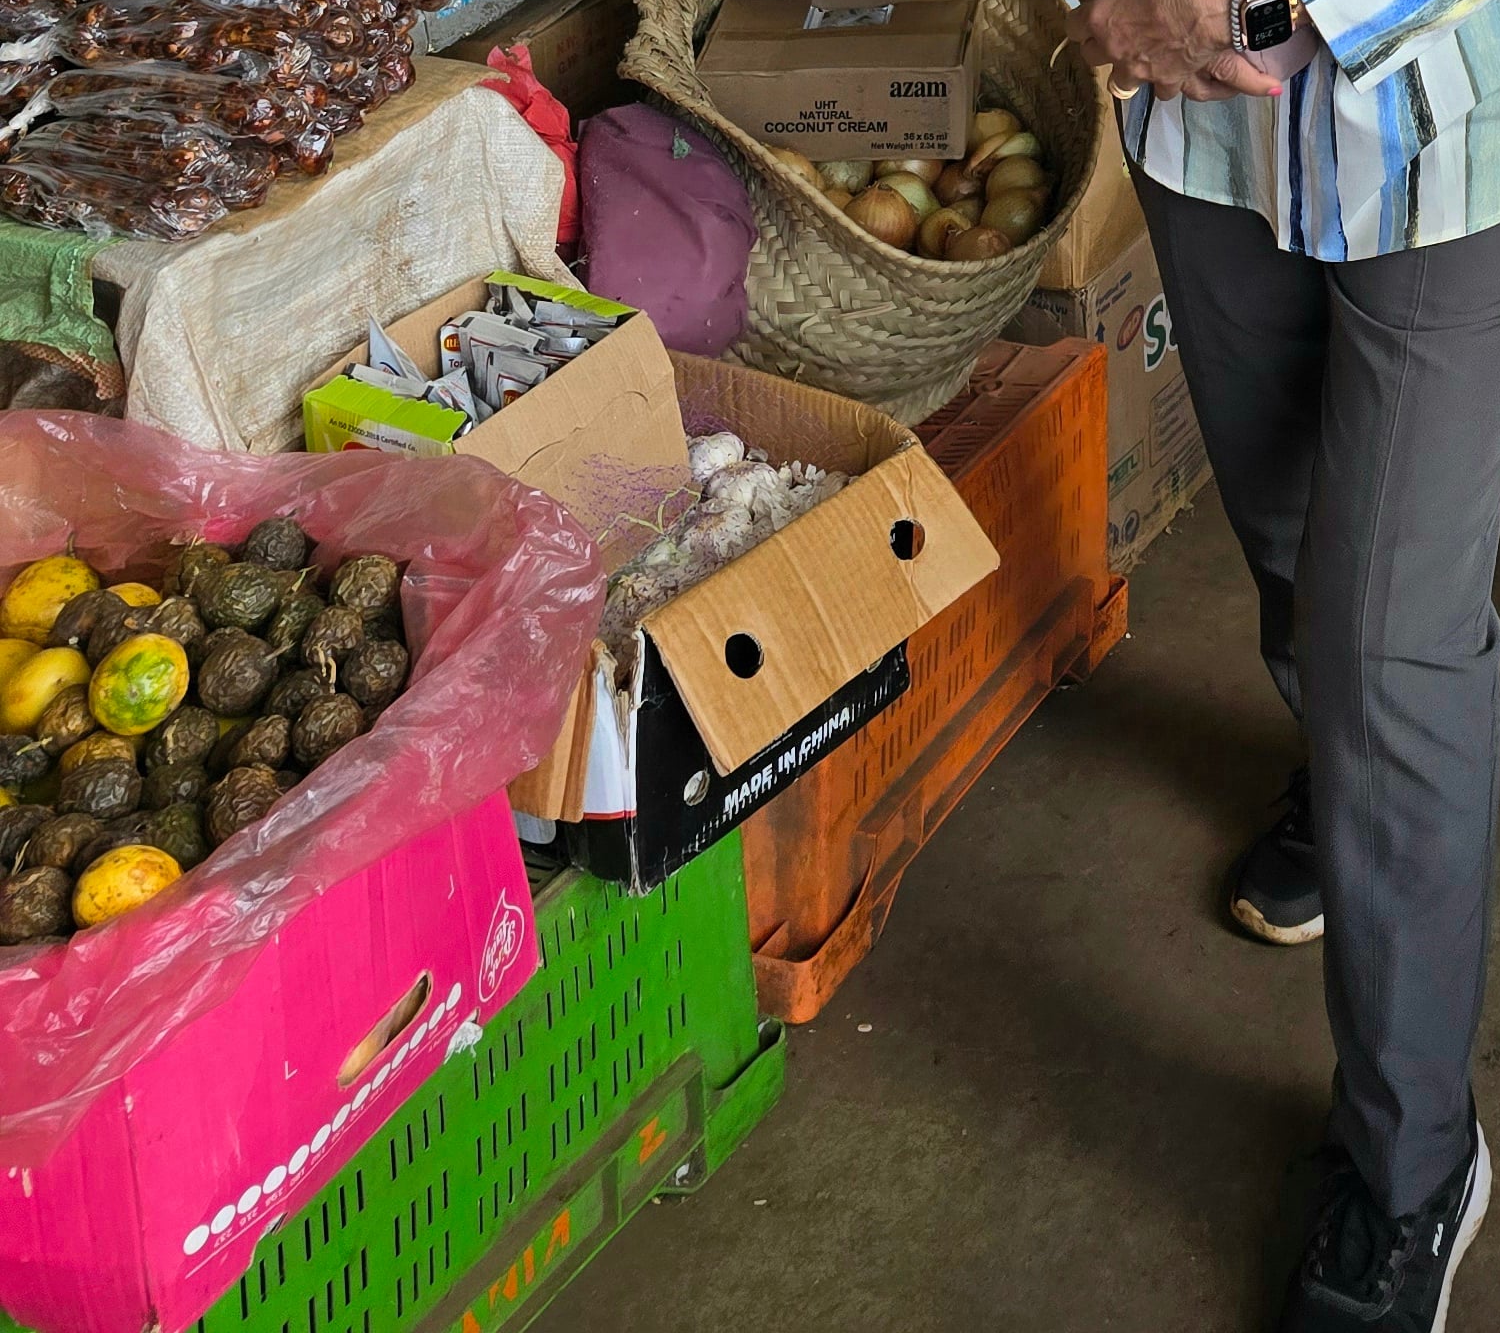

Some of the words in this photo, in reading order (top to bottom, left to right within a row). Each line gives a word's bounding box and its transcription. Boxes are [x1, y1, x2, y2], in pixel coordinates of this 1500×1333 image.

[889, 80, 948, 99] azam
[814, 100, 838, 110] UHT
[799, 110, 853, 120] NATURAL
[764, 121, 835, 134] COCONUT
[837, 121, 888, 133] CREAM
[923, 132, 935, 141] 65
[885, 141, 914, 151] Weight
[721, 763, 774, 816] MADE
[774, 744, 799, 778] IN
[797, 706, 853, 757] CHINA
